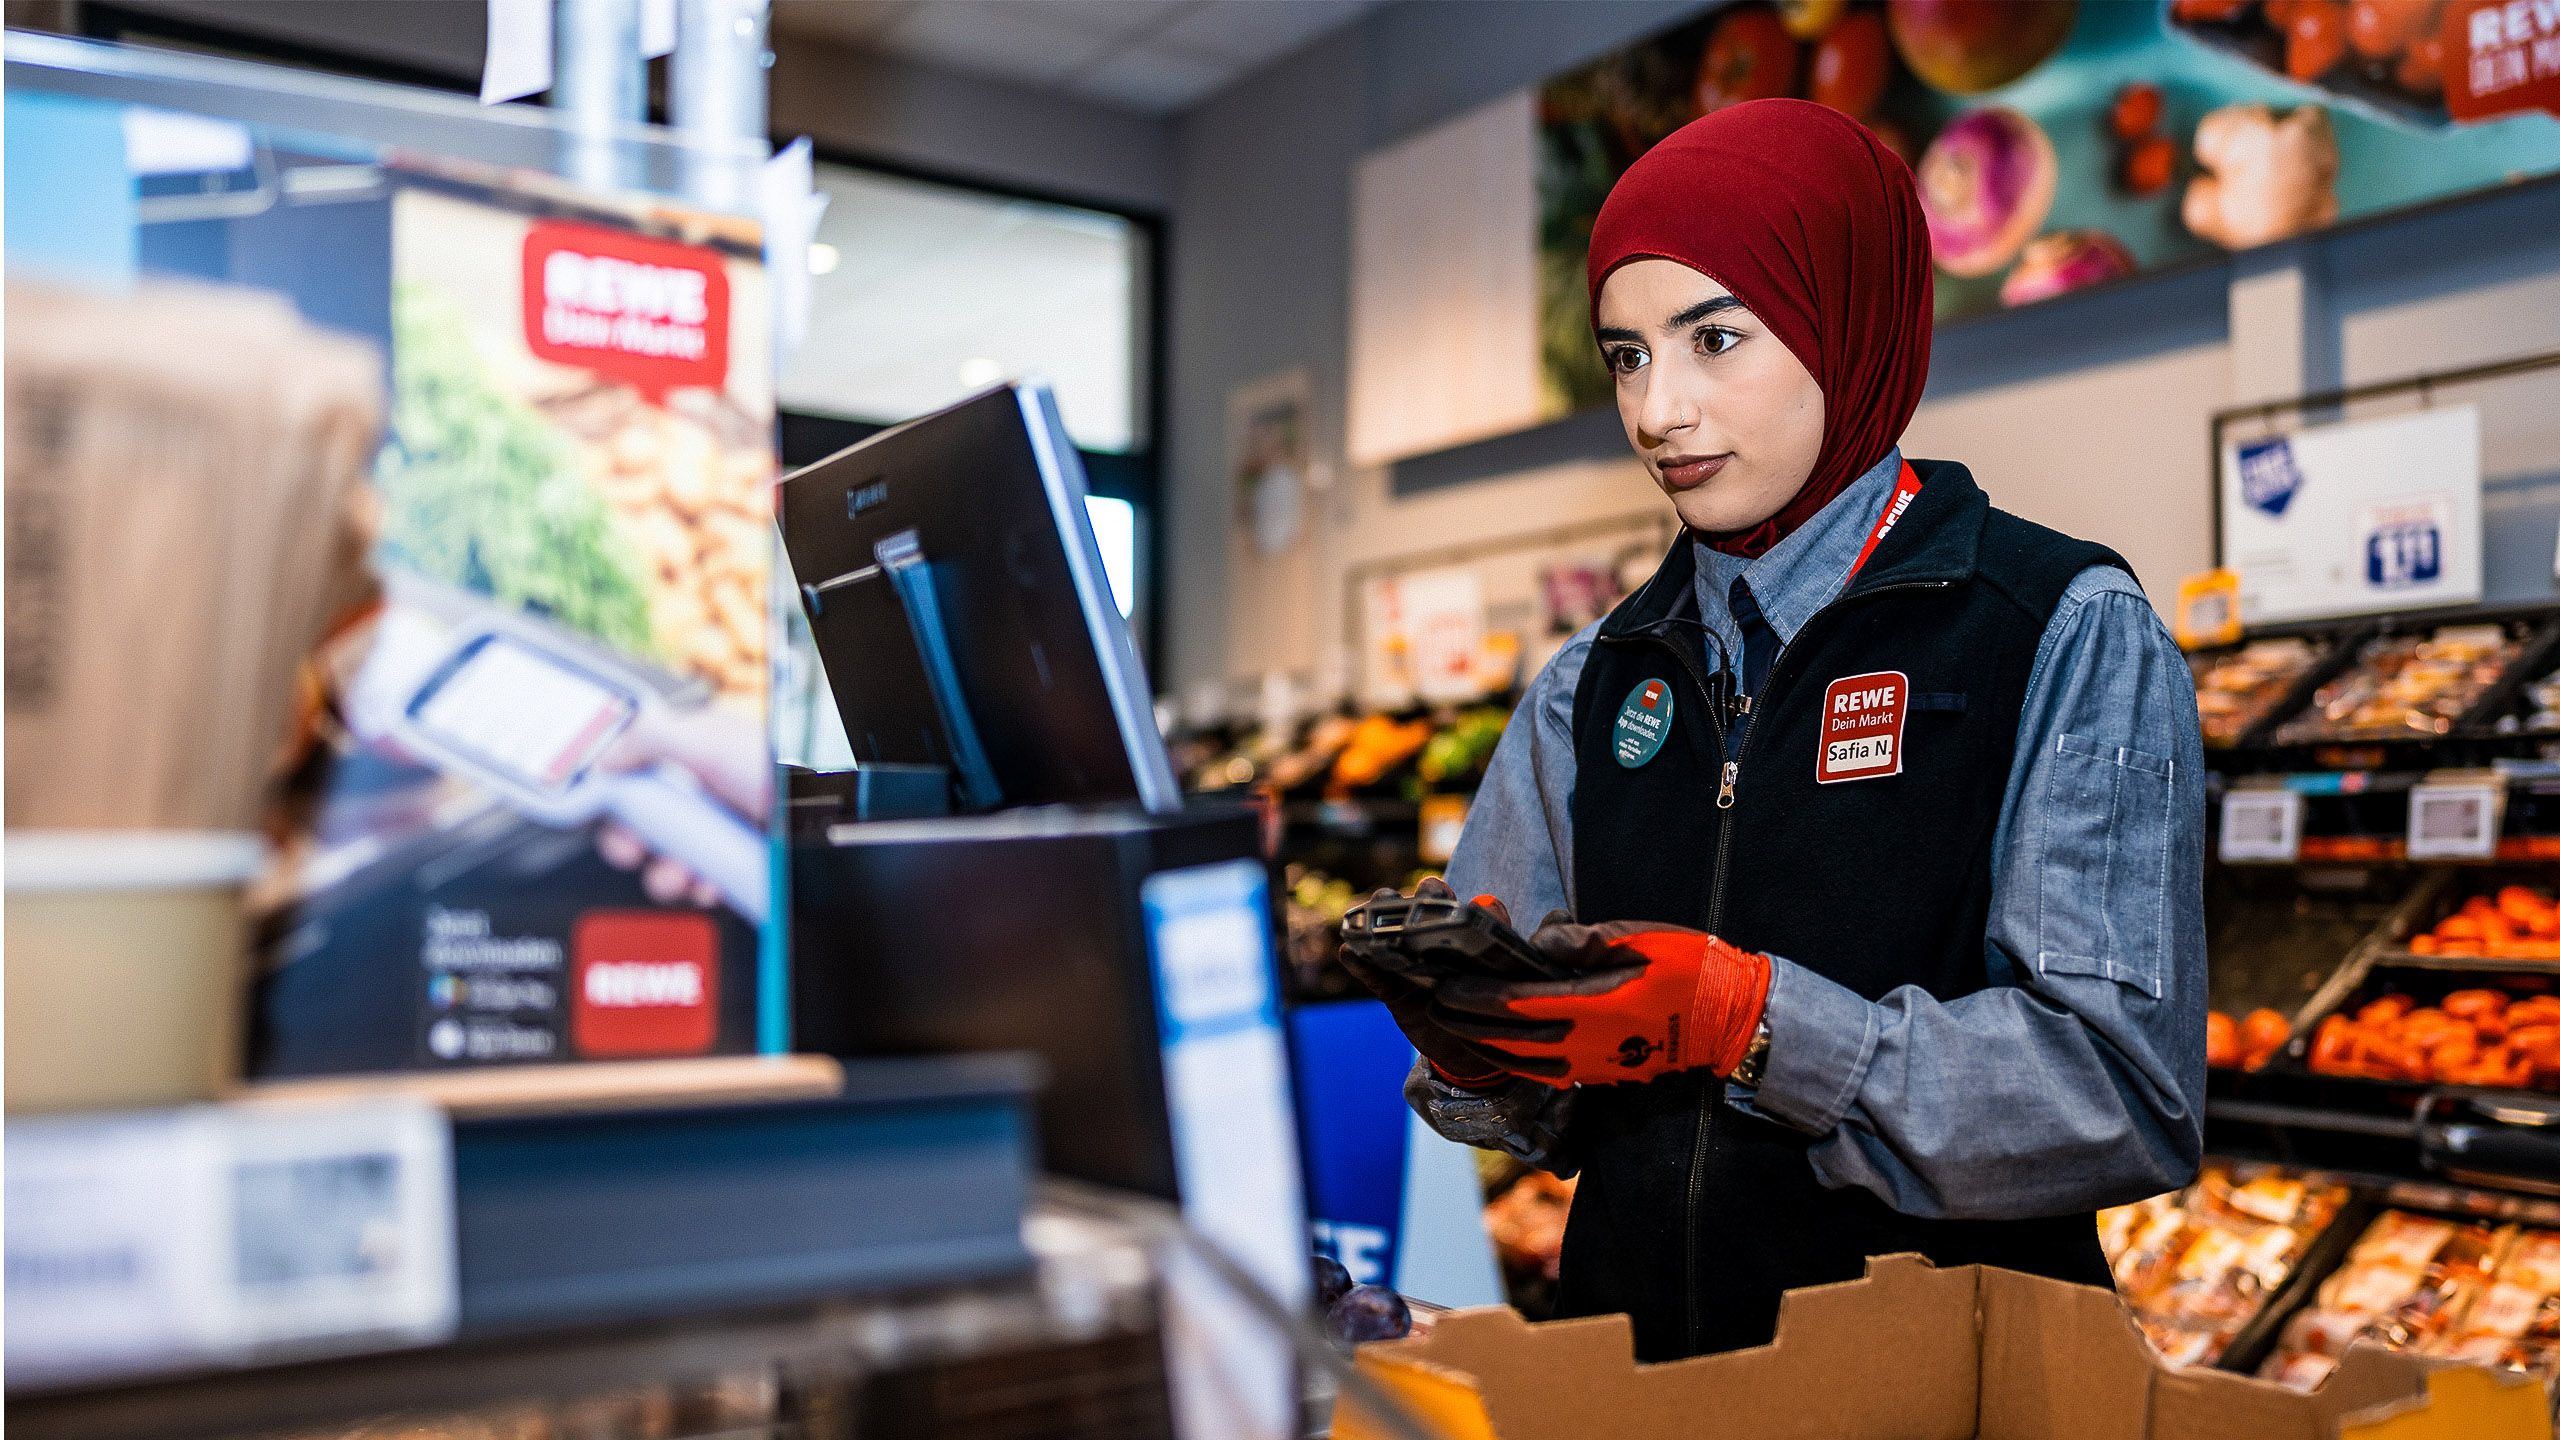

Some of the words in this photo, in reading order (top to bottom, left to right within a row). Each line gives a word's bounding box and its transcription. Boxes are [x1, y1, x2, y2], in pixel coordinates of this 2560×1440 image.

[544, 249, 708, 326] REWE
[1833, 686, 1896, 714] REWE
[1643, 714, 1661, 729] REWE
[1831, 717, 1855, 731] Dein
[1858, 711, 1894, 728] Markt
[1828, 742, 1869, 761] Safia
[1875, 740, 1892, 756] N.
[584, 960, 703, 1007] REWE
